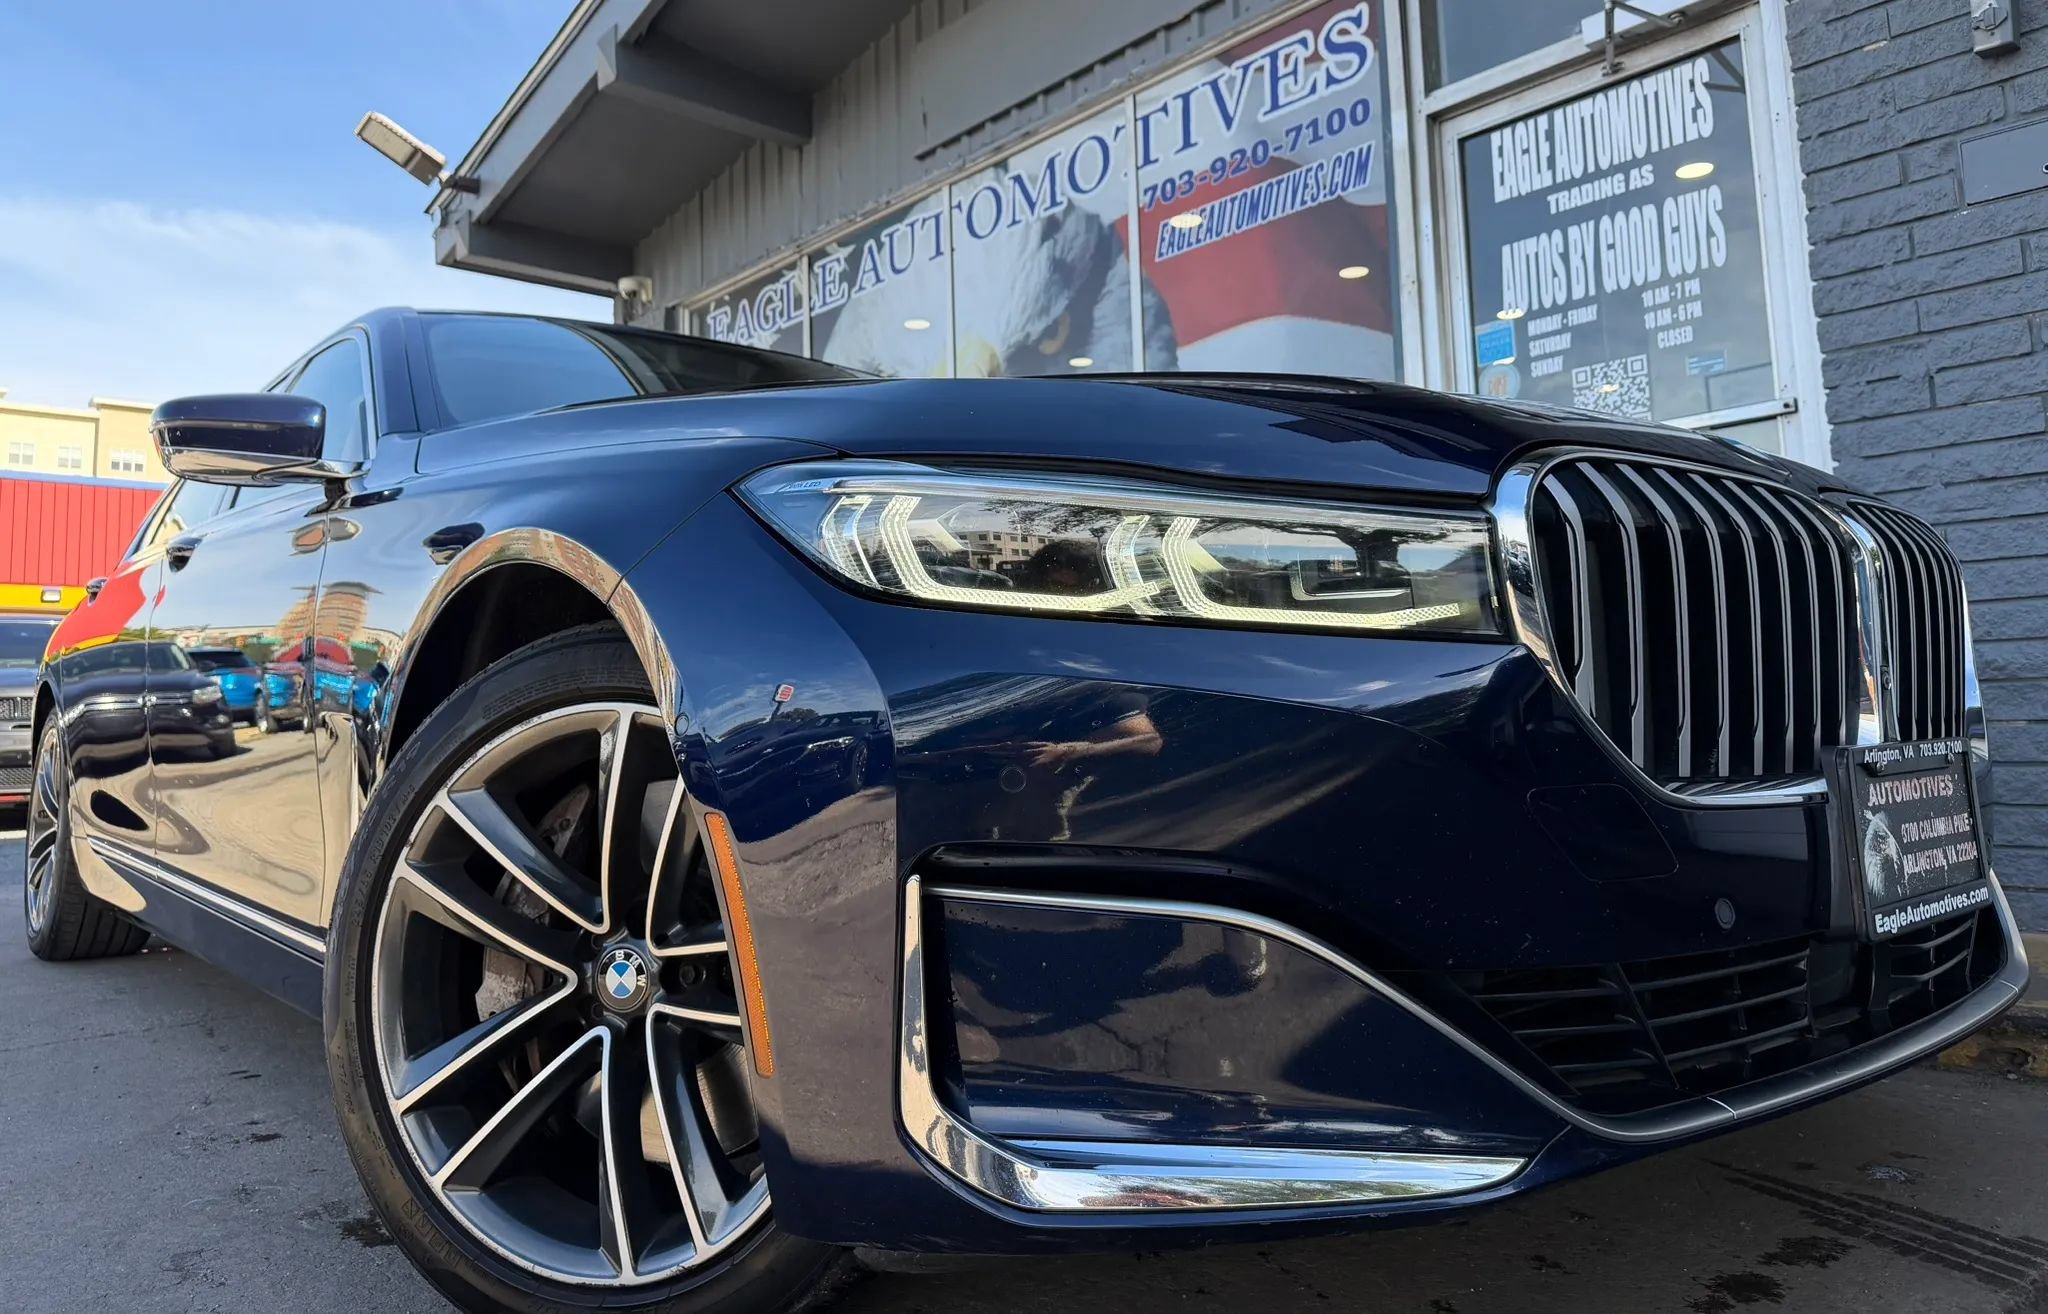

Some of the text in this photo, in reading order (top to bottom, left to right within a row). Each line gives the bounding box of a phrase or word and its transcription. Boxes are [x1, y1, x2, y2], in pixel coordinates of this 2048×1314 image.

[1490, 57, 1714, 203] EAGLE AUTOMOTIVES
[1143, 98, 1370, 211] 703-920-7100
[707, 2, 1372, 343] EAGLE AUTOMOTIVES
[1156, 143, 1374, 261] EAGLEAUTOMOTIVES.COM
[1547, 164, 1655, 215] TRADING AS
[1501, 184, 1727, 317] AUTOS BY GOOD GUYS
[1641, 290, 1654, 308] 10
[1654, 285, 1670, 305] AM
[1684, 278, 1701, 298] PM
[1527, 314, 1562, 337] MONDAY
[1567, 304, 1598, 327] FRIDAY
[1644, 311, 1656, 330] 10
[1656, 307, 1672, 327] AM
[1678, 304, 1686, 322] 6
[1685, 300, 1703, 320] PM
[1529, 332, 1572, 357] SATURDAY
[1657, 325, 1694, 349] CLOSED
[1530, 355, 1563, 378] SUNDAY
[1864, 740, 1962, 765] Arlington, VA 703.920.7100
[1868, 774, 1954, 806] AUTOMOTIVES
[1919, 815, 1954, 840] COLUMBIA
[1945, 844, 1957, 864] VA
[1957, 840, 1978, 862] 22204
[1875, 886, 1989, 934] EagleAutomotives.com
[615, 950, 647, 986] BMW
